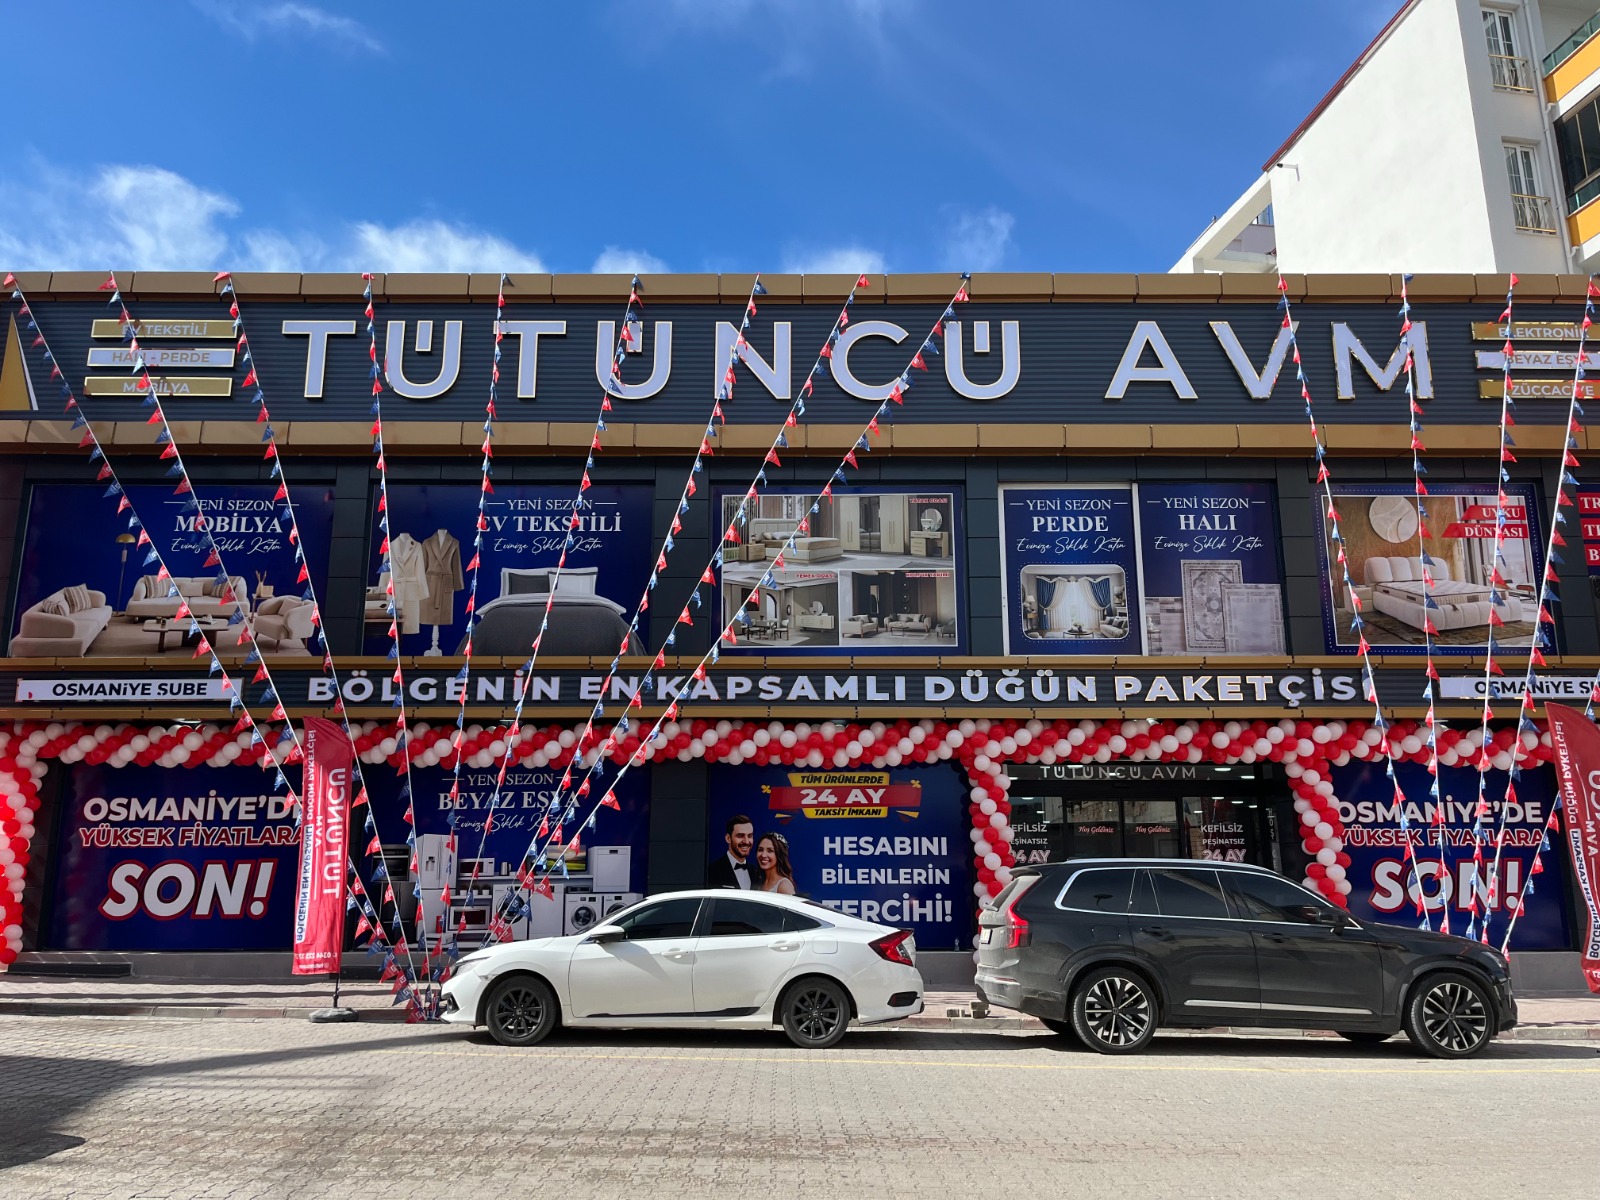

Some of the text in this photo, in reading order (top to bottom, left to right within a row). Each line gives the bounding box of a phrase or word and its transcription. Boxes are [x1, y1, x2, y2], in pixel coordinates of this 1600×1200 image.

[145, 322, 207, 336] TEKSTİLİ
[160, 352, 210, 363] PERDE
[281, 320, 1434, 401] TÜTÜNCÜ AVM
[226, 499, 275, 511] SEZON
[507, 497, 592, 511] YENİ SEZON
[1026, 497, 1112, 511] YENİ SEZON
[1163, 496, 1249, 509] YENİ SEZON
[513, 512, 622, 532] TEKSTİLİ
[1031, 515, 1109, 533] PERDE
[1178, 514, 1237, 531] HALI
[307, 669, 560, 702] BÖLGENİN
[579, 675, 639, 701] EN
[656, 675, 906, 701] KAPSAMLI
[923, 669, 1097, 702] DÜĞÜN
[467, 773, 554, 786] YEN SEZON
[800, 774, 884, 784] TÜM ÜRÜNLERDE
[1039, 765, 1196, 779] TÜTÜNCÜ AVM
[799, 788, 886, 805] 24 AY
[814, 806, 882, 816] TAKSİT İMKANI
[79, 822, 175, 848] YÜKSEK
[1200, 822, 1244, 833] KEFİLSİZ
[1202, 836, 1246, 847] PEŞİNATSIZ
[1338, 824, 1425, 848] YÜKSEK
[823, 836, 948, 856] HESABINI
[1028, 849, 1051, 864] AY
[822, 863, 950, 885] BİLENLERİN
[100, 860, 276, 919] SON!
[1370, 859, 1522, 912] SON!
